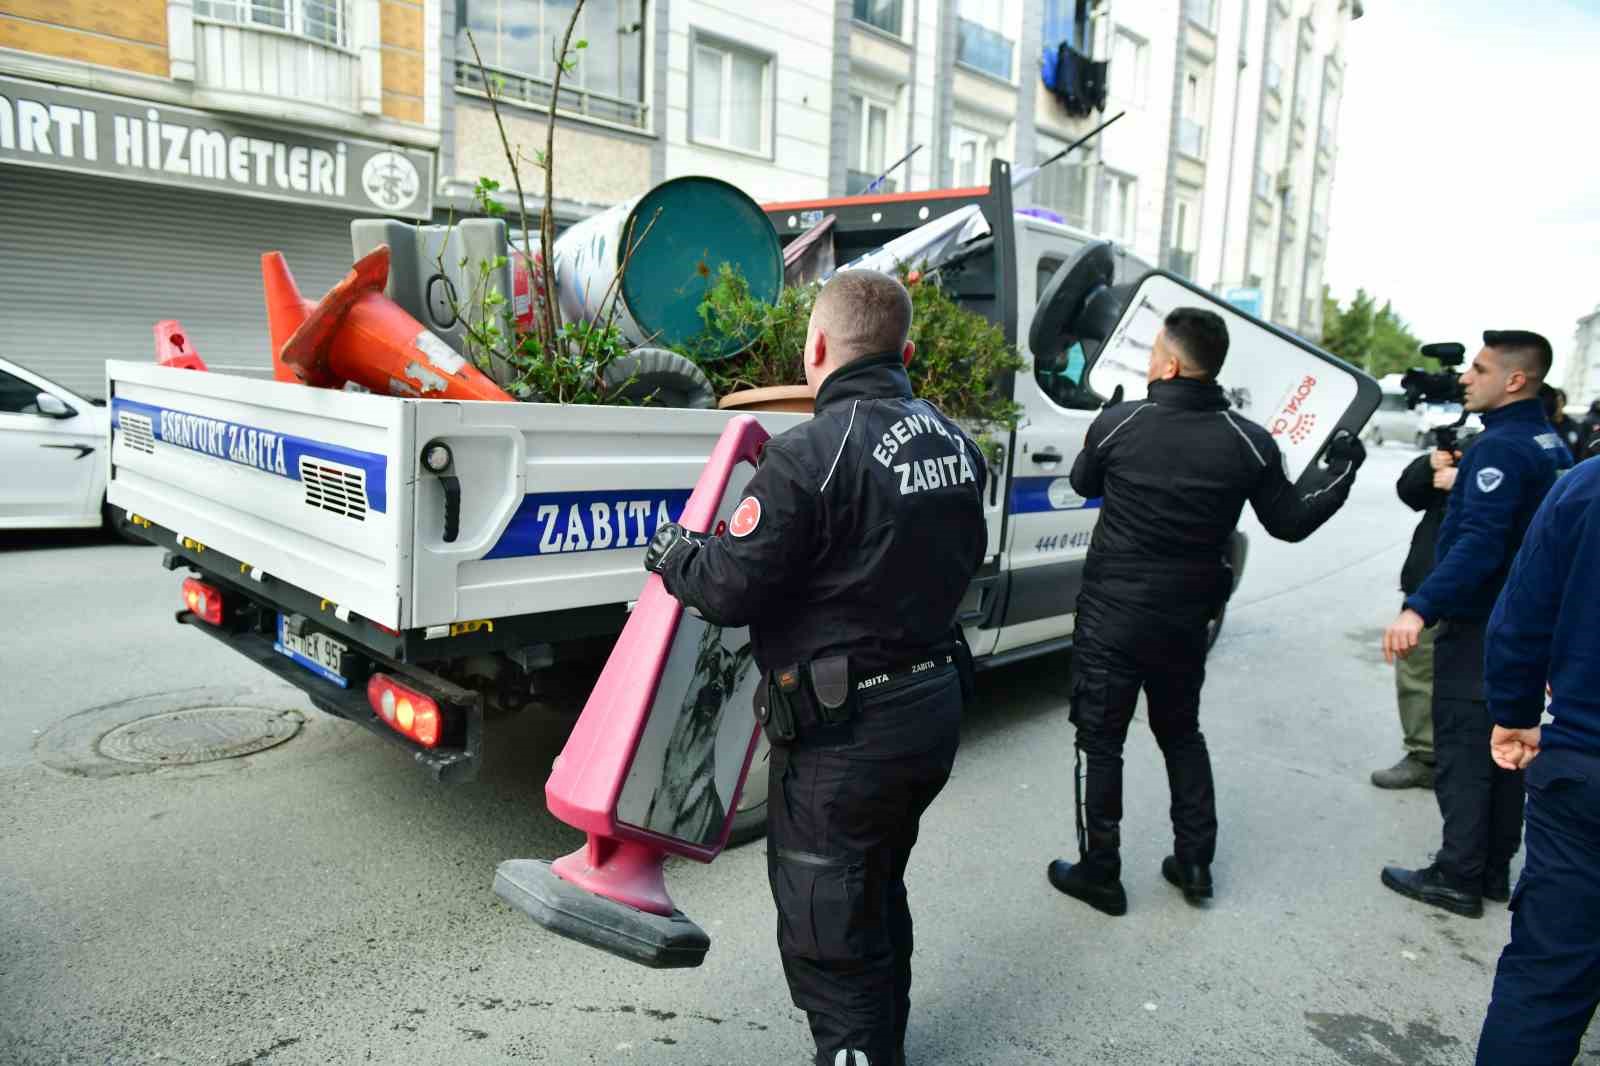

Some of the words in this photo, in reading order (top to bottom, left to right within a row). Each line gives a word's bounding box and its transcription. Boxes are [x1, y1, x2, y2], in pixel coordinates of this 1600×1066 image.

[114, 108, 345, 196] HİZMETLERİ
[1282, 375, 1316, 415] ROYAL
[160, 409, 227, 457] ESENYURT
[229, 425, 287, 475] ZABITA
[872, 413, 965, 468] ESENYUT
[1270, 418, 1288, 436] CA
[893, 454, 976, 495] ZABITA
[857, 673, 890, 690] ABITA
